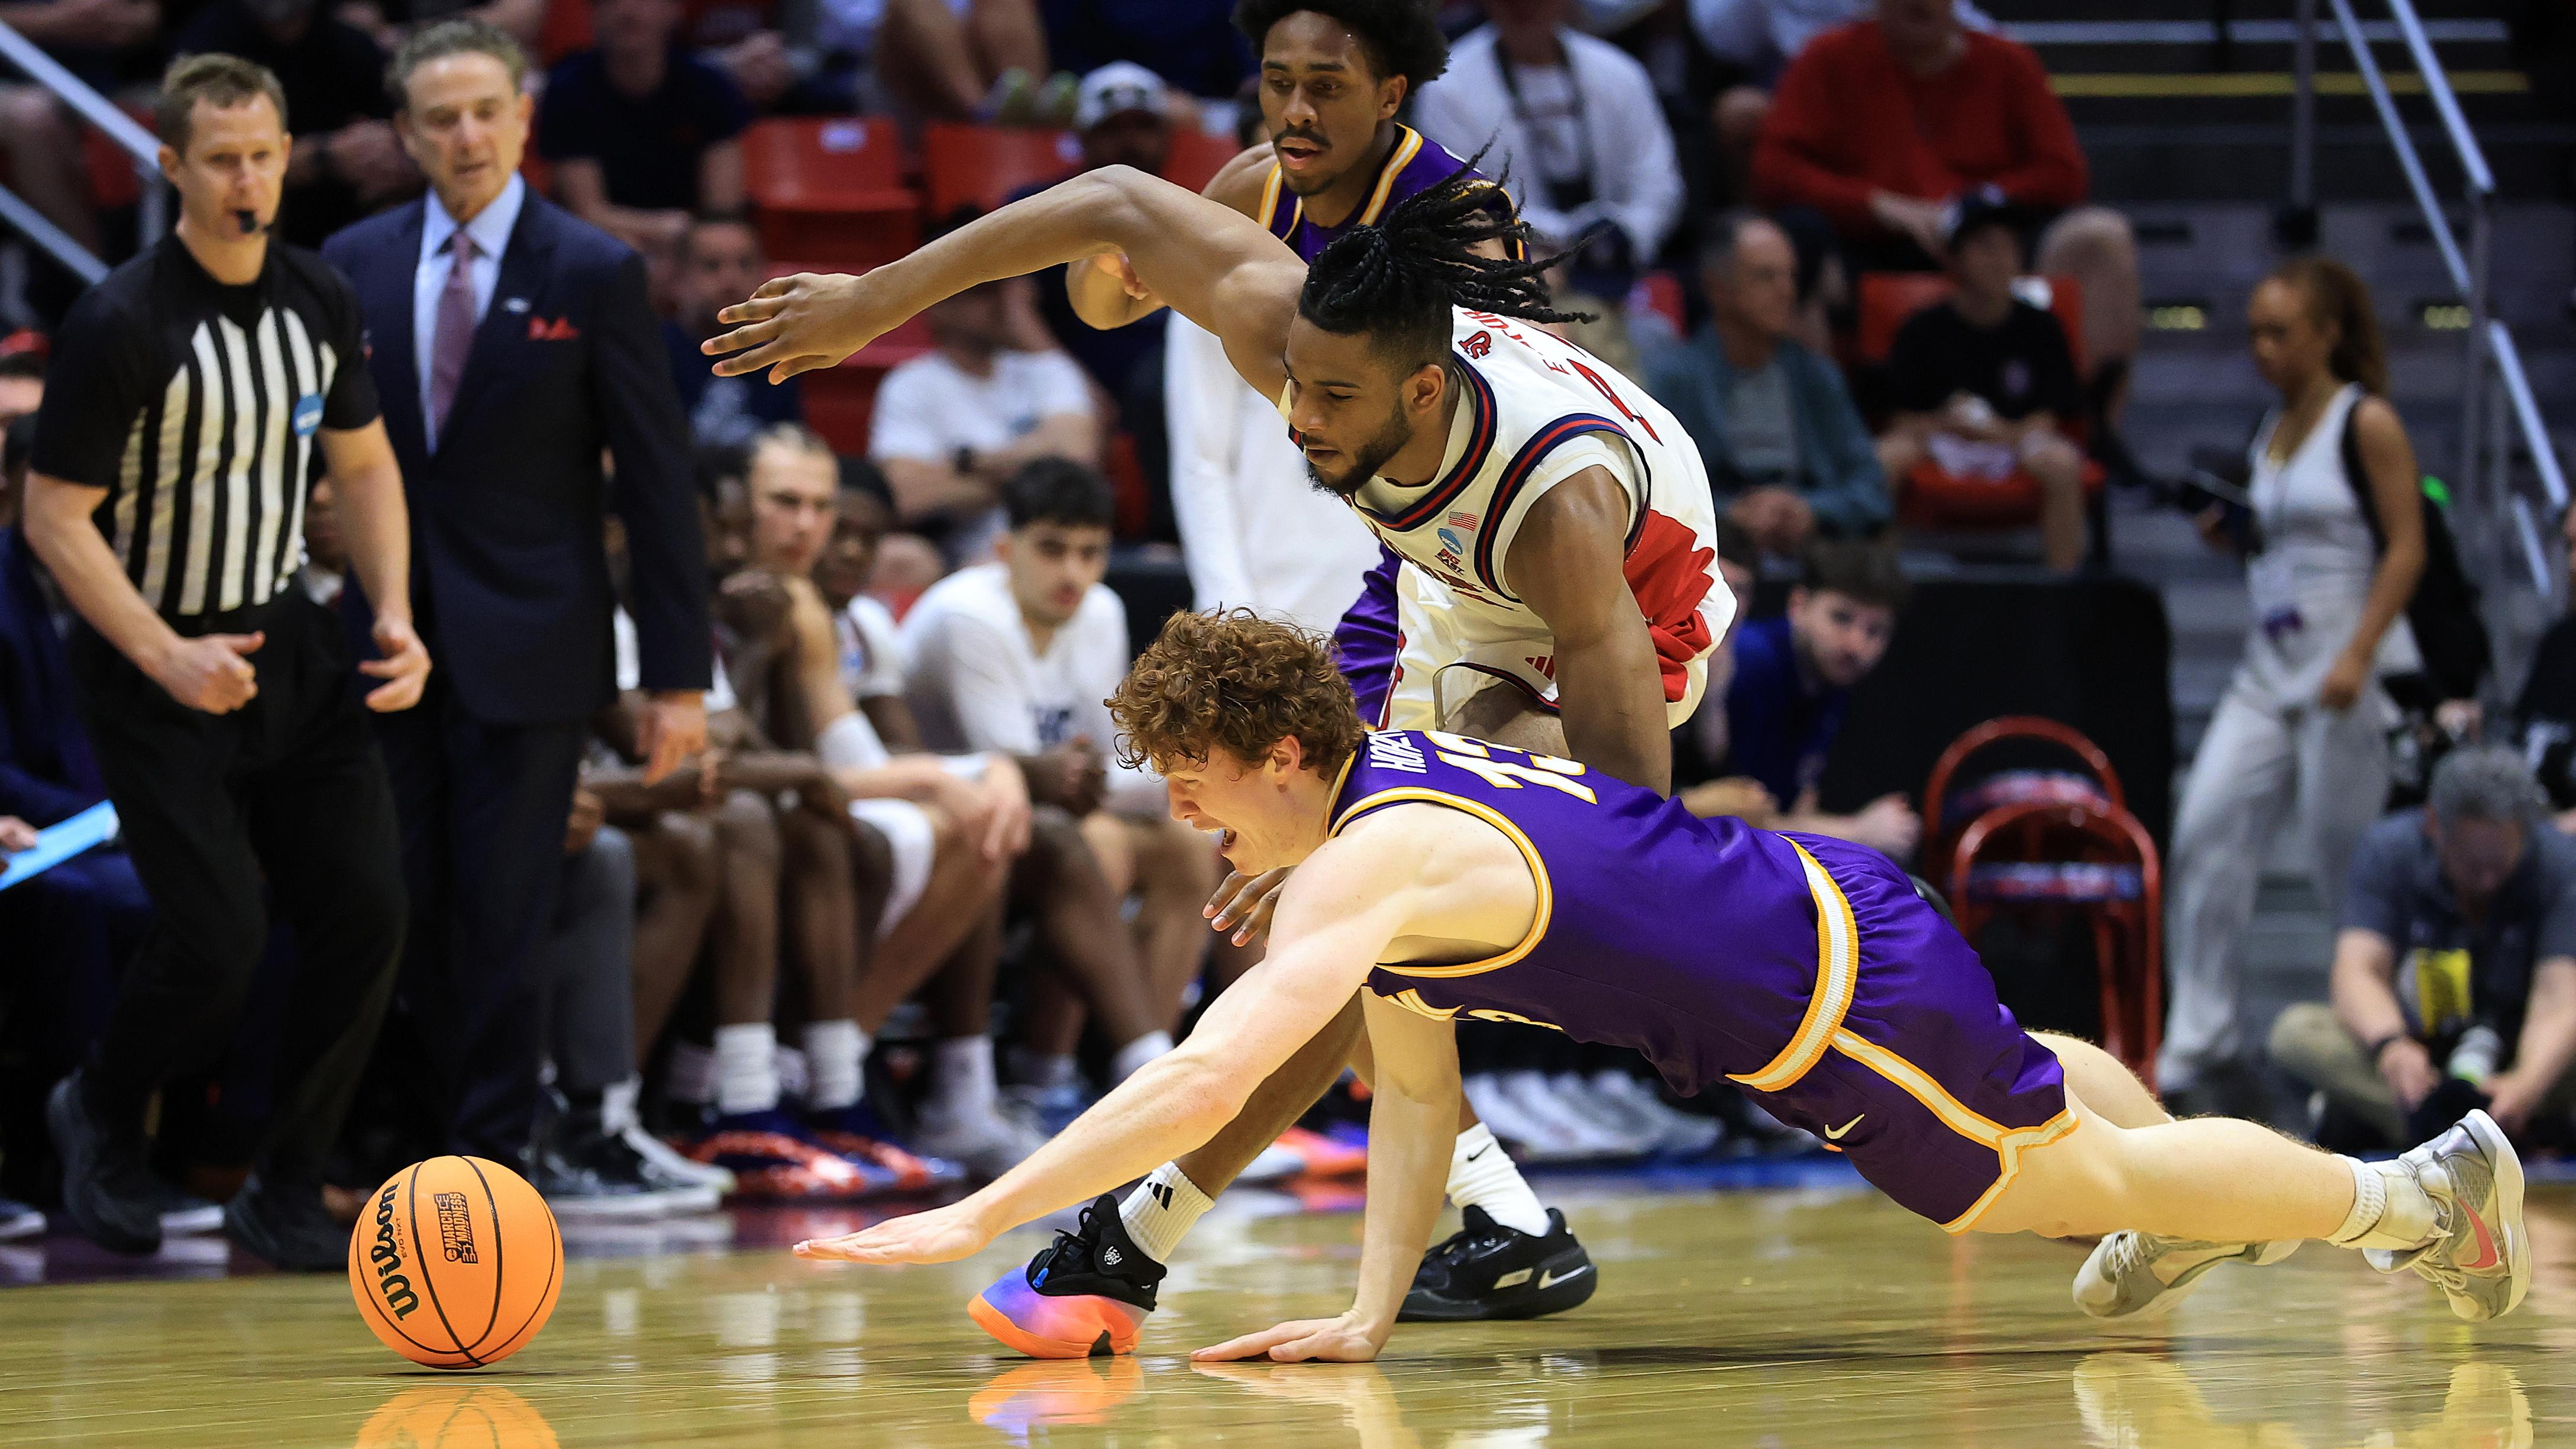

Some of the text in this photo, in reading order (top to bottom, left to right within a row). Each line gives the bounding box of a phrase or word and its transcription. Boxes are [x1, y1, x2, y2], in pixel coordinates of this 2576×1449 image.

[1437, 552, 1465, 574] EAST
[1441, 548, 1461, 564] BIG
[1421, 730, 1597, 805] 13
[439, 1211, 457, 1248] MARCH
[450, 1193, 468, 1242] MADNESS
[371, 1182, 419, 1321] Wilson
